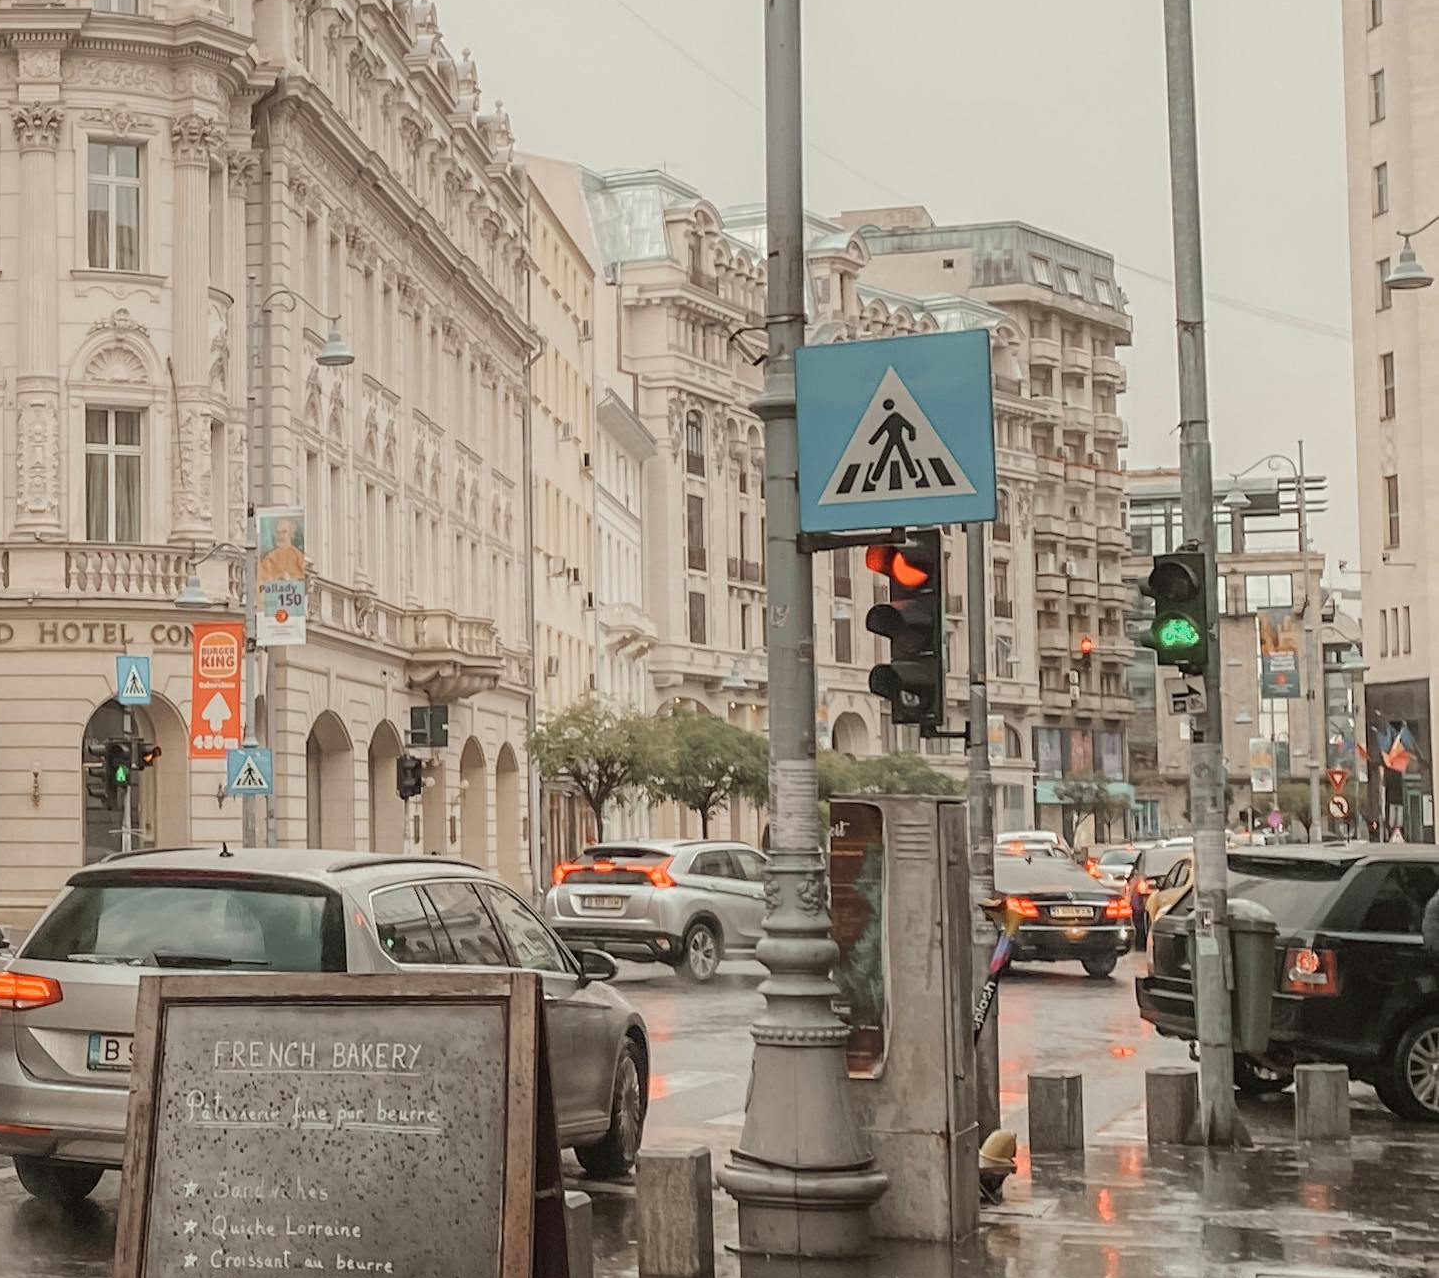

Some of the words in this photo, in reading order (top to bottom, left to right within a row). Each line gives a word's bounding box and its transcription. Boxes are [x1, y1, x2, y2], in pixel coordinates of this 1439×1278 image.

[259, 583, 298, 594] Pallady
[278, 593, 302, 606] 150
[39, 622, 134, 645] HOTEL
[202, 647, 235, 655] BURGER
[202, 656, 235, 667] KING
[105, 1040, 119, 1060] B
[214, 1041, 316, 1067] FRENCH
[332, 1042, 422, 1069] BAKERY
[292, 1096, 327, 1129] fine
[377, 1098, 437, 1121] beurre
[211, 1215, 276, 1240] Quiche
[286, 1216, 361, 1238] Lorraine
[210, 1249, 291, 1270] Croissant
[304, 1257, 324, 1269] au
[337, 1253, 393, 1273] beurre
